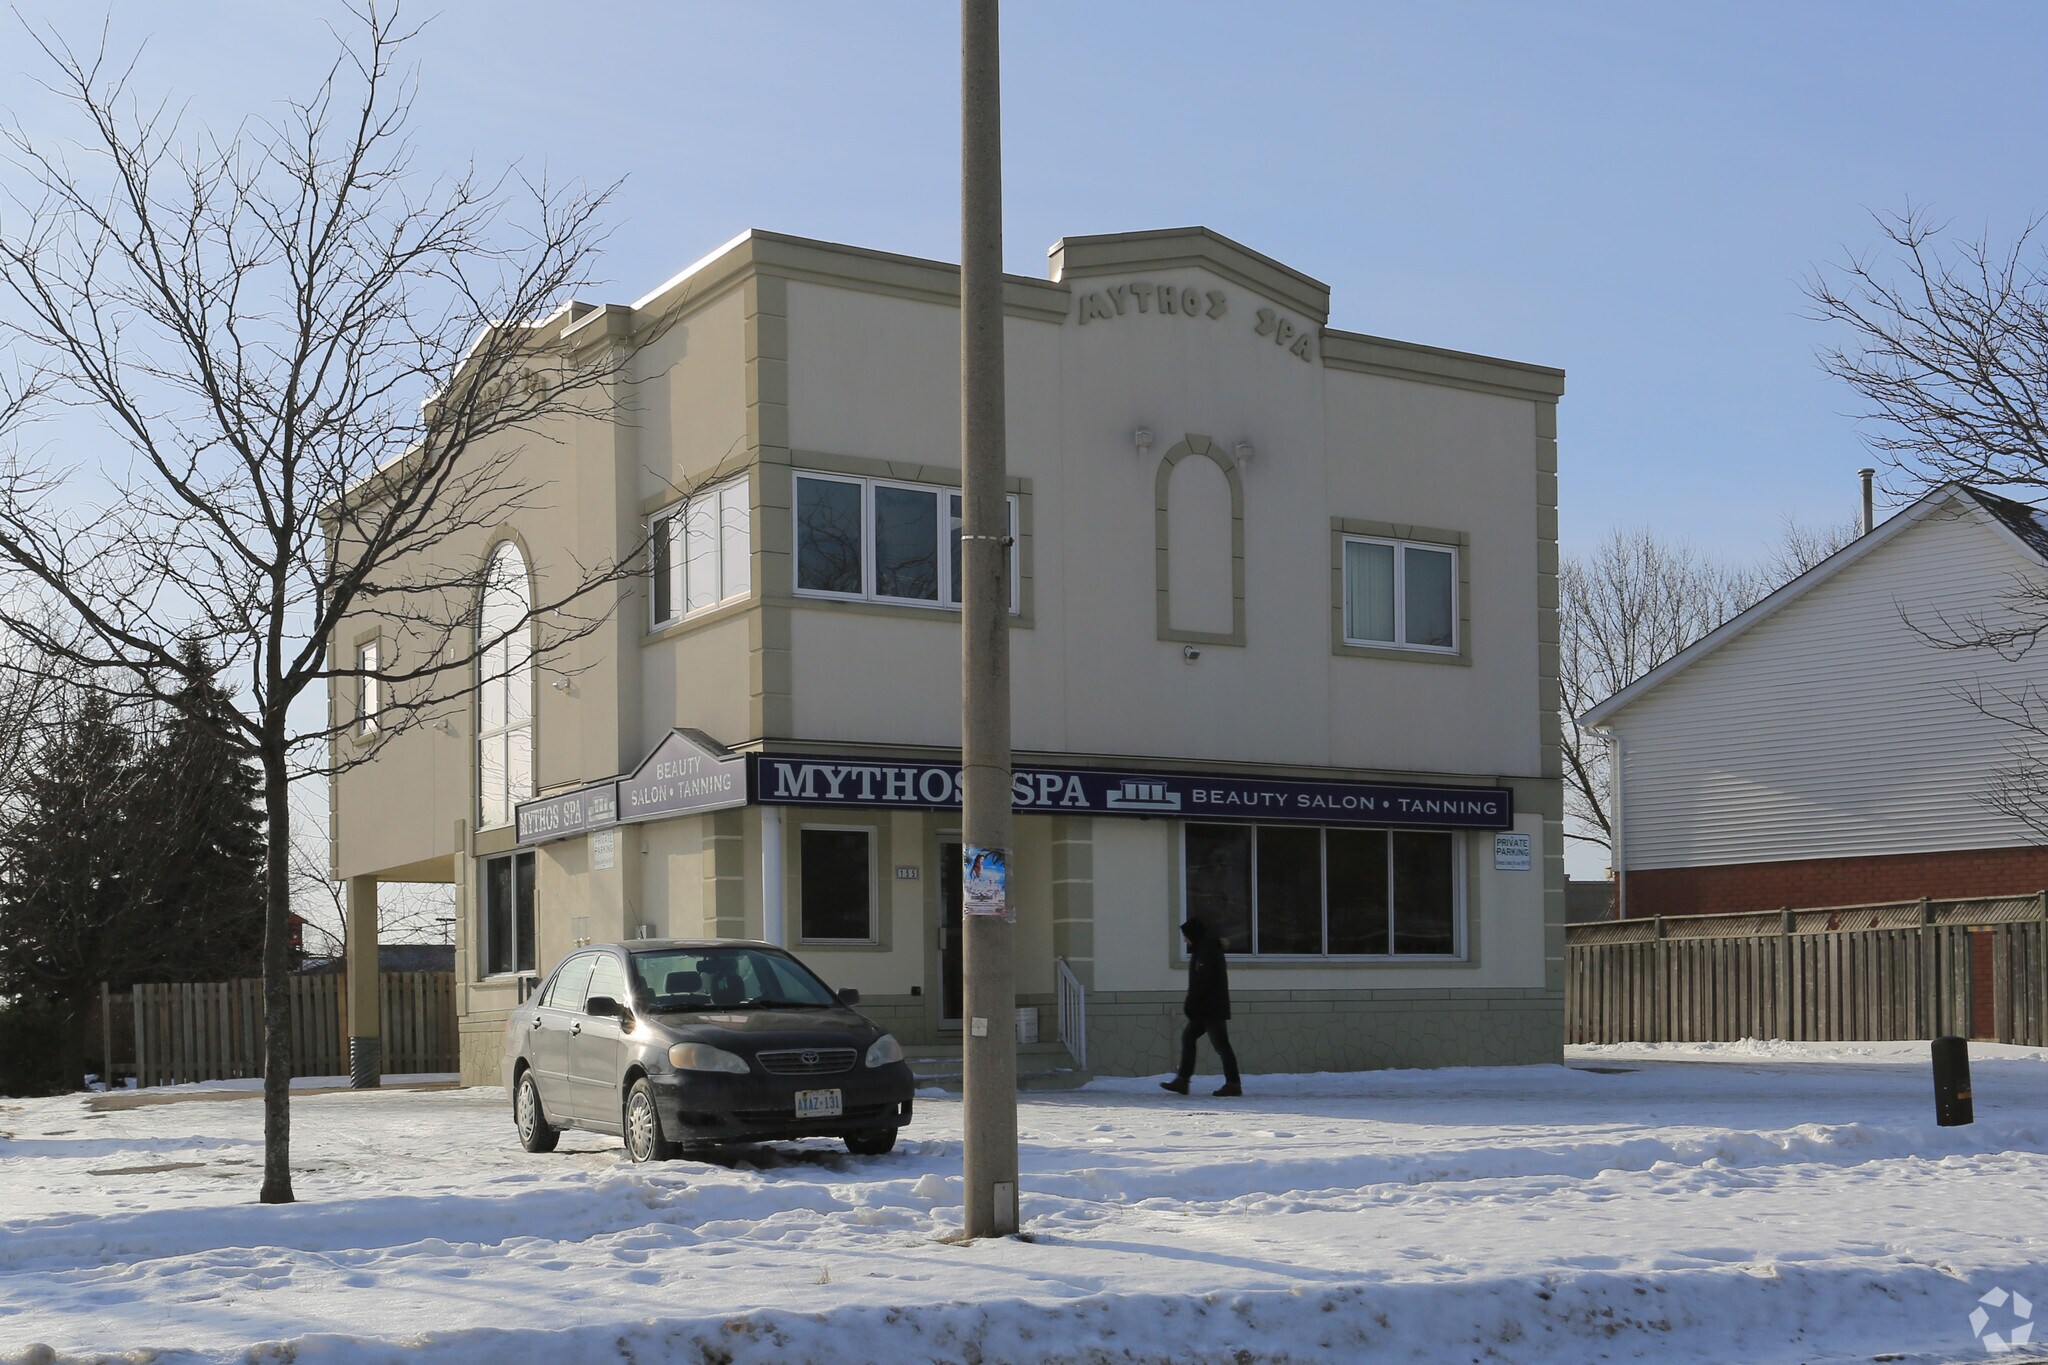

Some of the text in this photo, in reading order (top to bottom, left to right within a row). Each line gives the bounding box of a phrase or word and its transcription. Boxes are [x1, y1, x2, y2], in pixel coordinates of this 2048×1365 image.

[1079, 282, 1312, 363] MYTHOS SPA
[656, 756, 702, 781] BEAUTY
[631, 773, 732, 806] SALON TANNING
[1011, 772, 1090, 807] SPA
[1192, 789, 1497, 815] BEAUTY SALON TANNING
[519, 799, 582, 836] MYTHOS SPA
[1496, 838, 1528, 847] PRIVATE
[1496, 848, 1529, 856] PARKING
